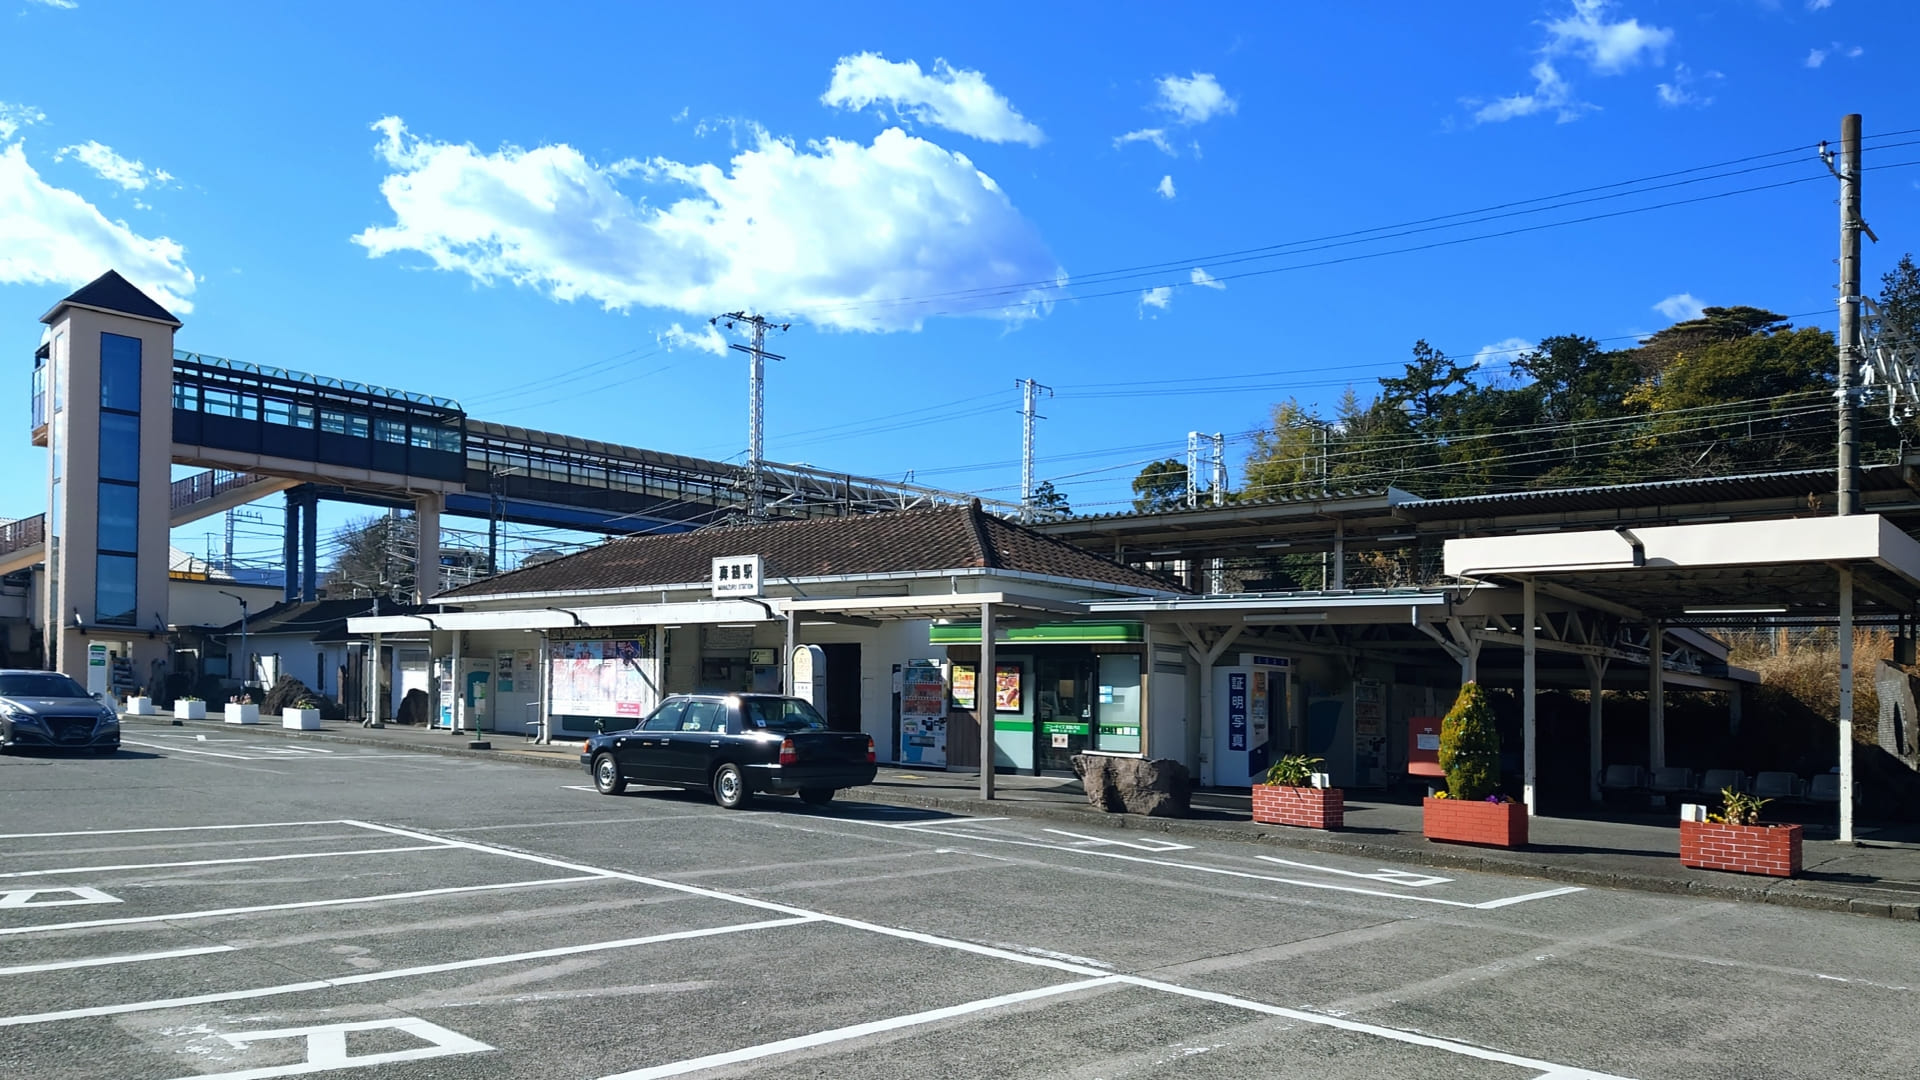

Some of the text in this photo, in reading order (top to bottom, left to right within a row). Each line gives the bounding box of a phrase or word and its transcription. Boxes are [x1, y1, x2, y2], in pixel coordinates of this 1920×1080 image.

[719, 563, 753, 581] 真鶴駅
[1231, 676, 1245, 747] 証明写真
